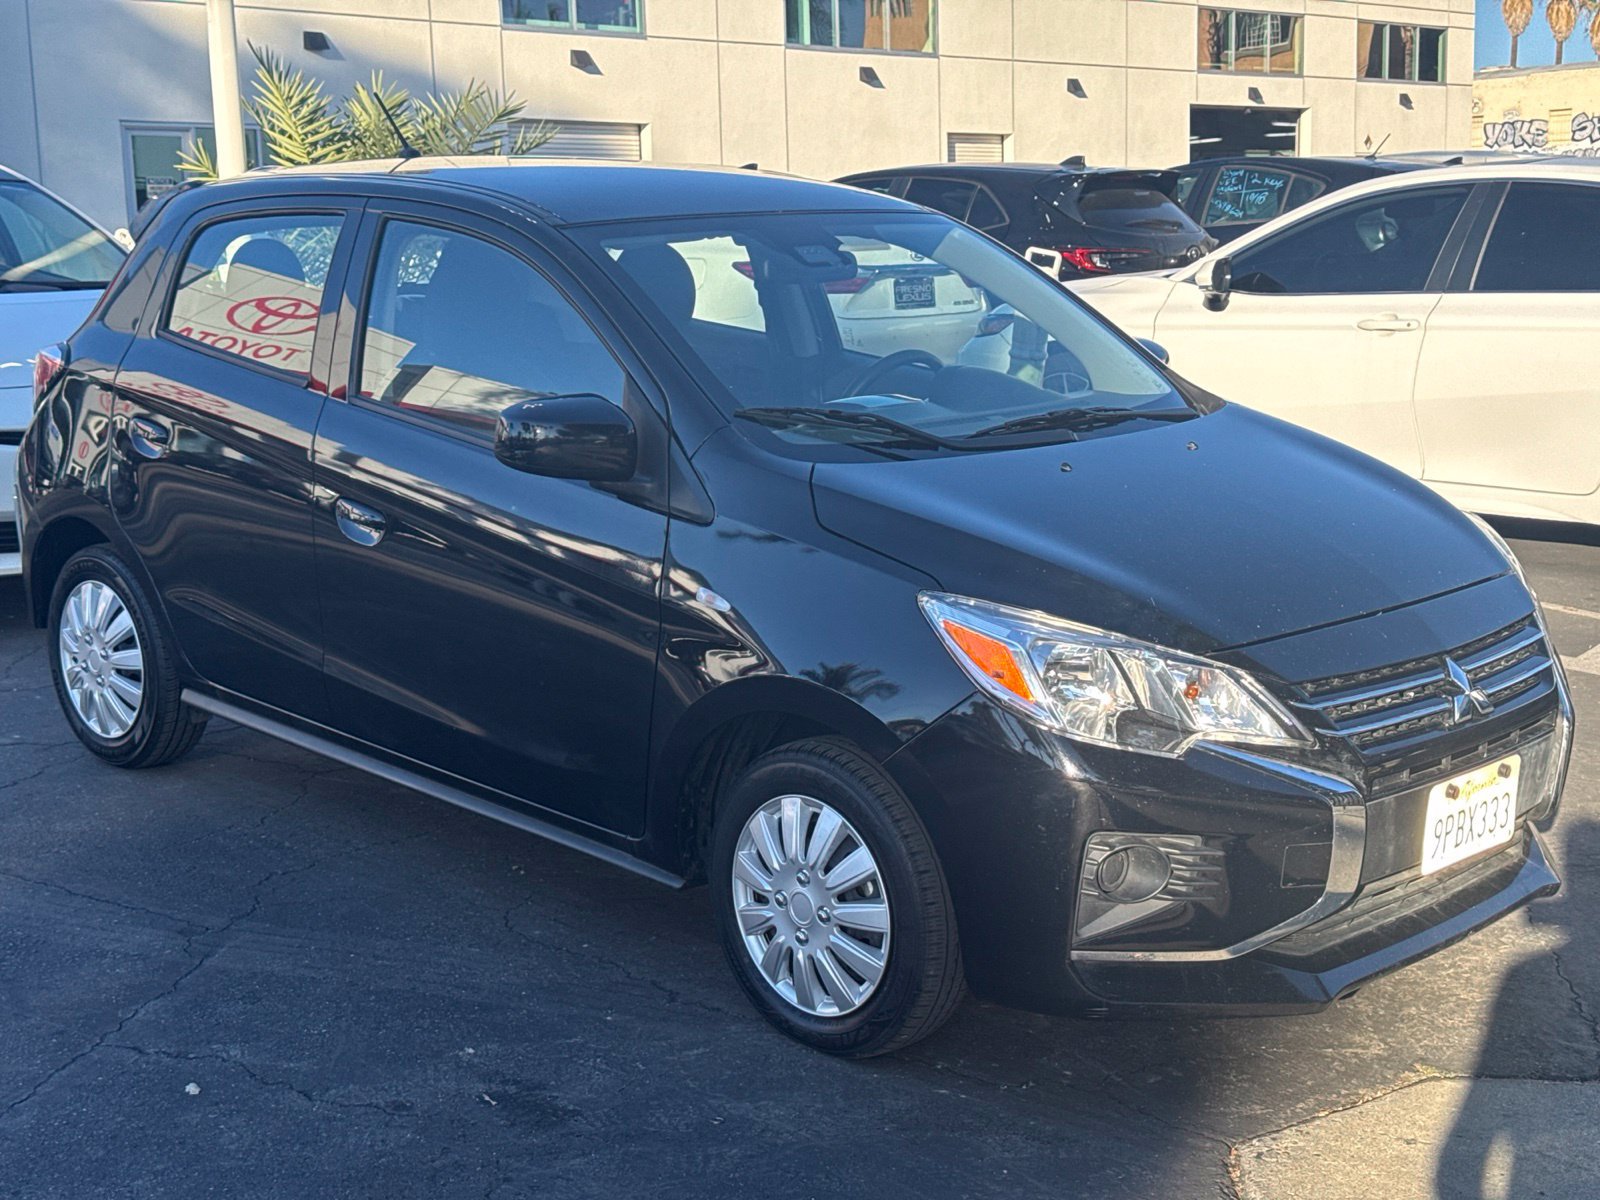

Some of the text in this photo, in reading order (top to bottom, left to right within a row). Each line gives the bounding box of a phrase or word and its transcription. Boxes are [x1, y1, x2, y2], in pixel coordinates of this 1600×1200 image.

[1484, 119, 1548, 148] YOKE
[895, 284, 932, 293] FRESNO
[896, 293, 932, 302] LEXUS
[1431, 792, 1511, 859] 9PBX333
